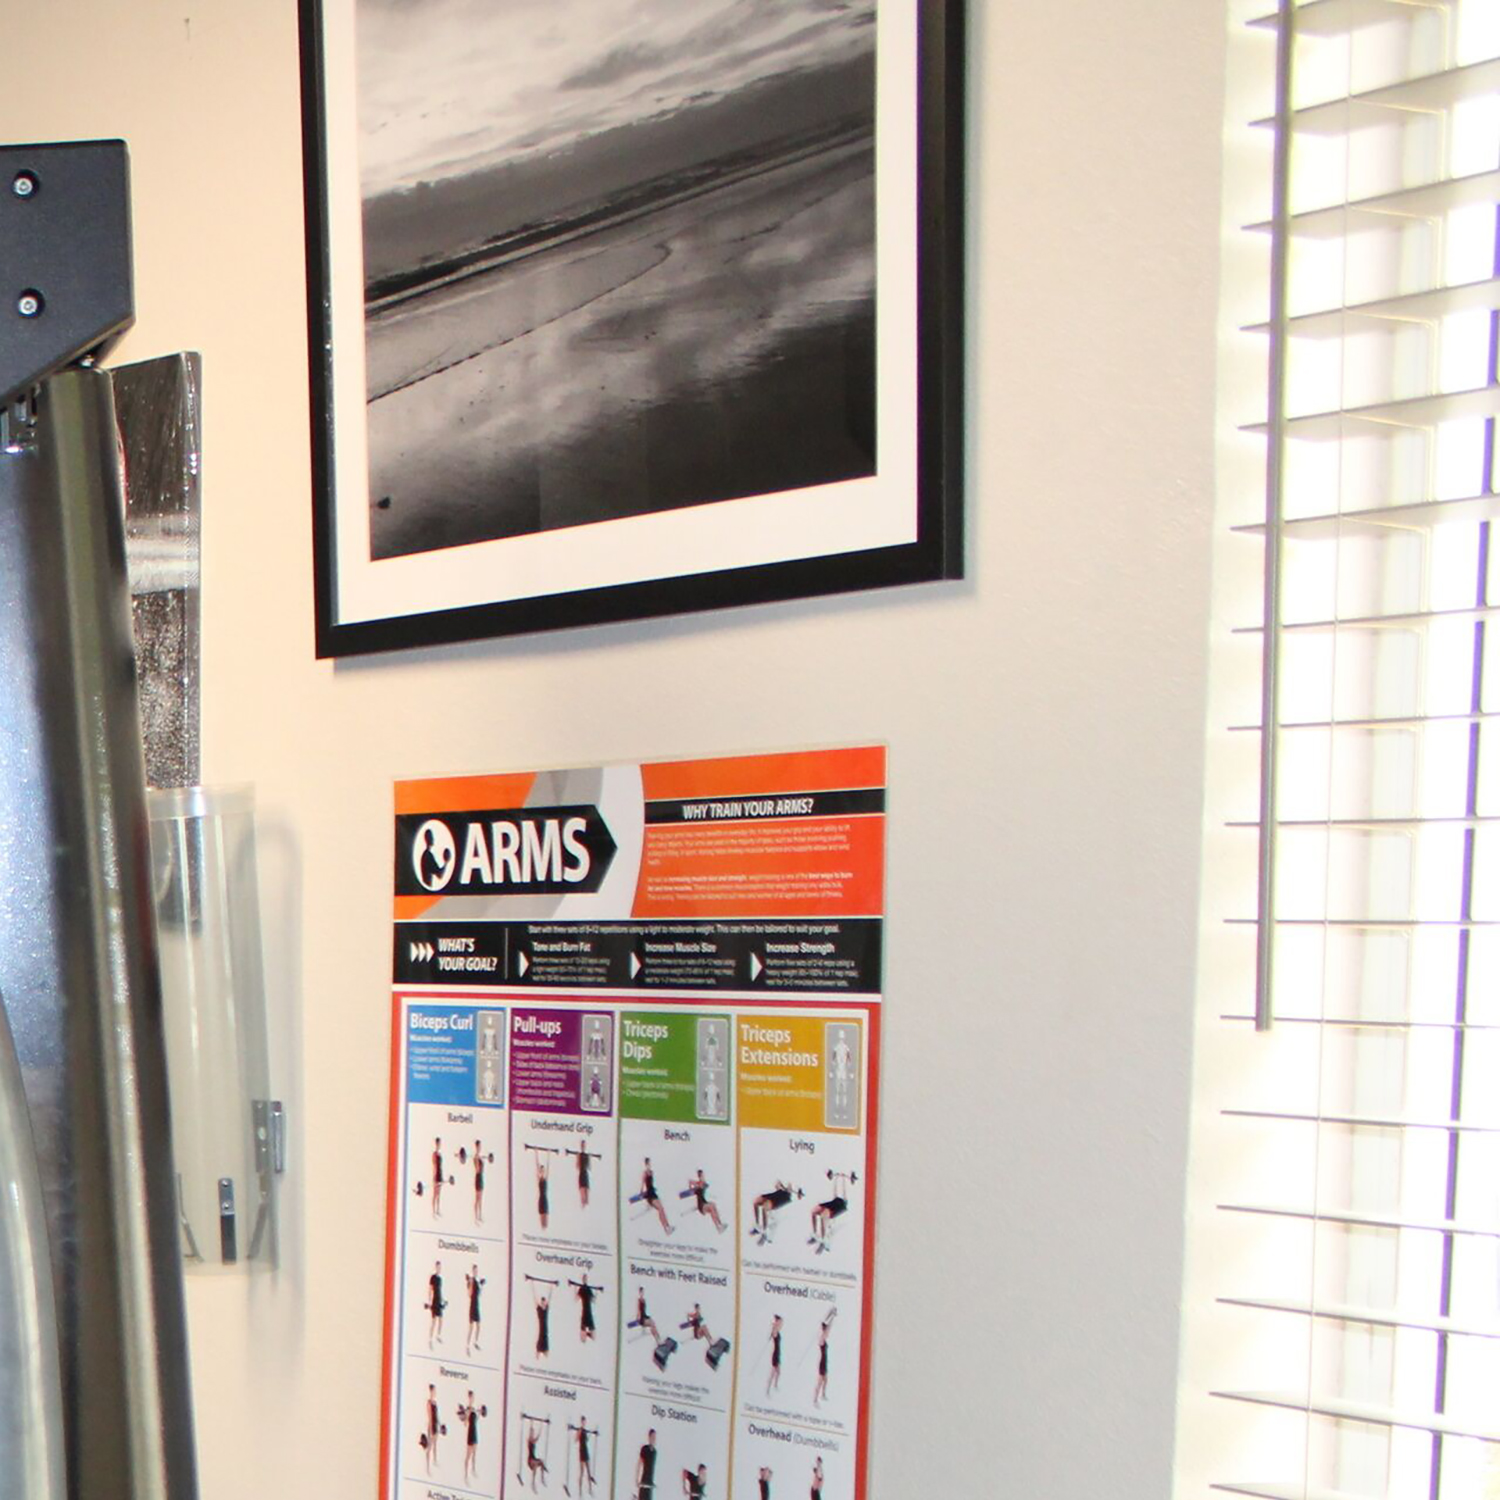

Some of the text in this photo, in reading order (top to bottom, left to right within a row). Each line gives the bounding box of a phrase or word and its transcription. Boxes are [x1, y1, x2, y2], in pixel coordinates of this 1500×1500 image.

[682, 798, 815, 820] WHY TRAIN YOUR ARMS?
[459, 817, 591, 885] ARMS
[437, 937, 476, 953] WHAT'S
[438, 957, 498, 972] YOUR GOAL?
[410, 1013, 473, 1033] Biceps Curl
[513, 1016, 562, 1038] Pull-ups
[623, 1020, 668, 1042] Triceps
[741, 1024, 791, 1046] Triceps
[622, 1041, 652, 1062] Dips
[741, 1047, 819, 1068] Extensions
[447, 1111, 473, 1124] Barbell
[531, 1118, 594, 1136] Underhand Grip
[664, 1128, 690, 1142] Bench
[790, 1139, 815, 1154] Lying
[438, 1238, 479, 1254] Dumbbells
[535, 1251, 594, 1270] Overhand Grip
[630, 1263, 728, 1287] Bench with Feet Raised
[763, 1281, 808, 1298] Overhead
[440, 1366, 469, 1381] Reverse
[543, 1385, 577, 1402] Assisted
[651, 1404, 698, 1424] Dip Station
[748, 1423, 792, 1443] Overhead
